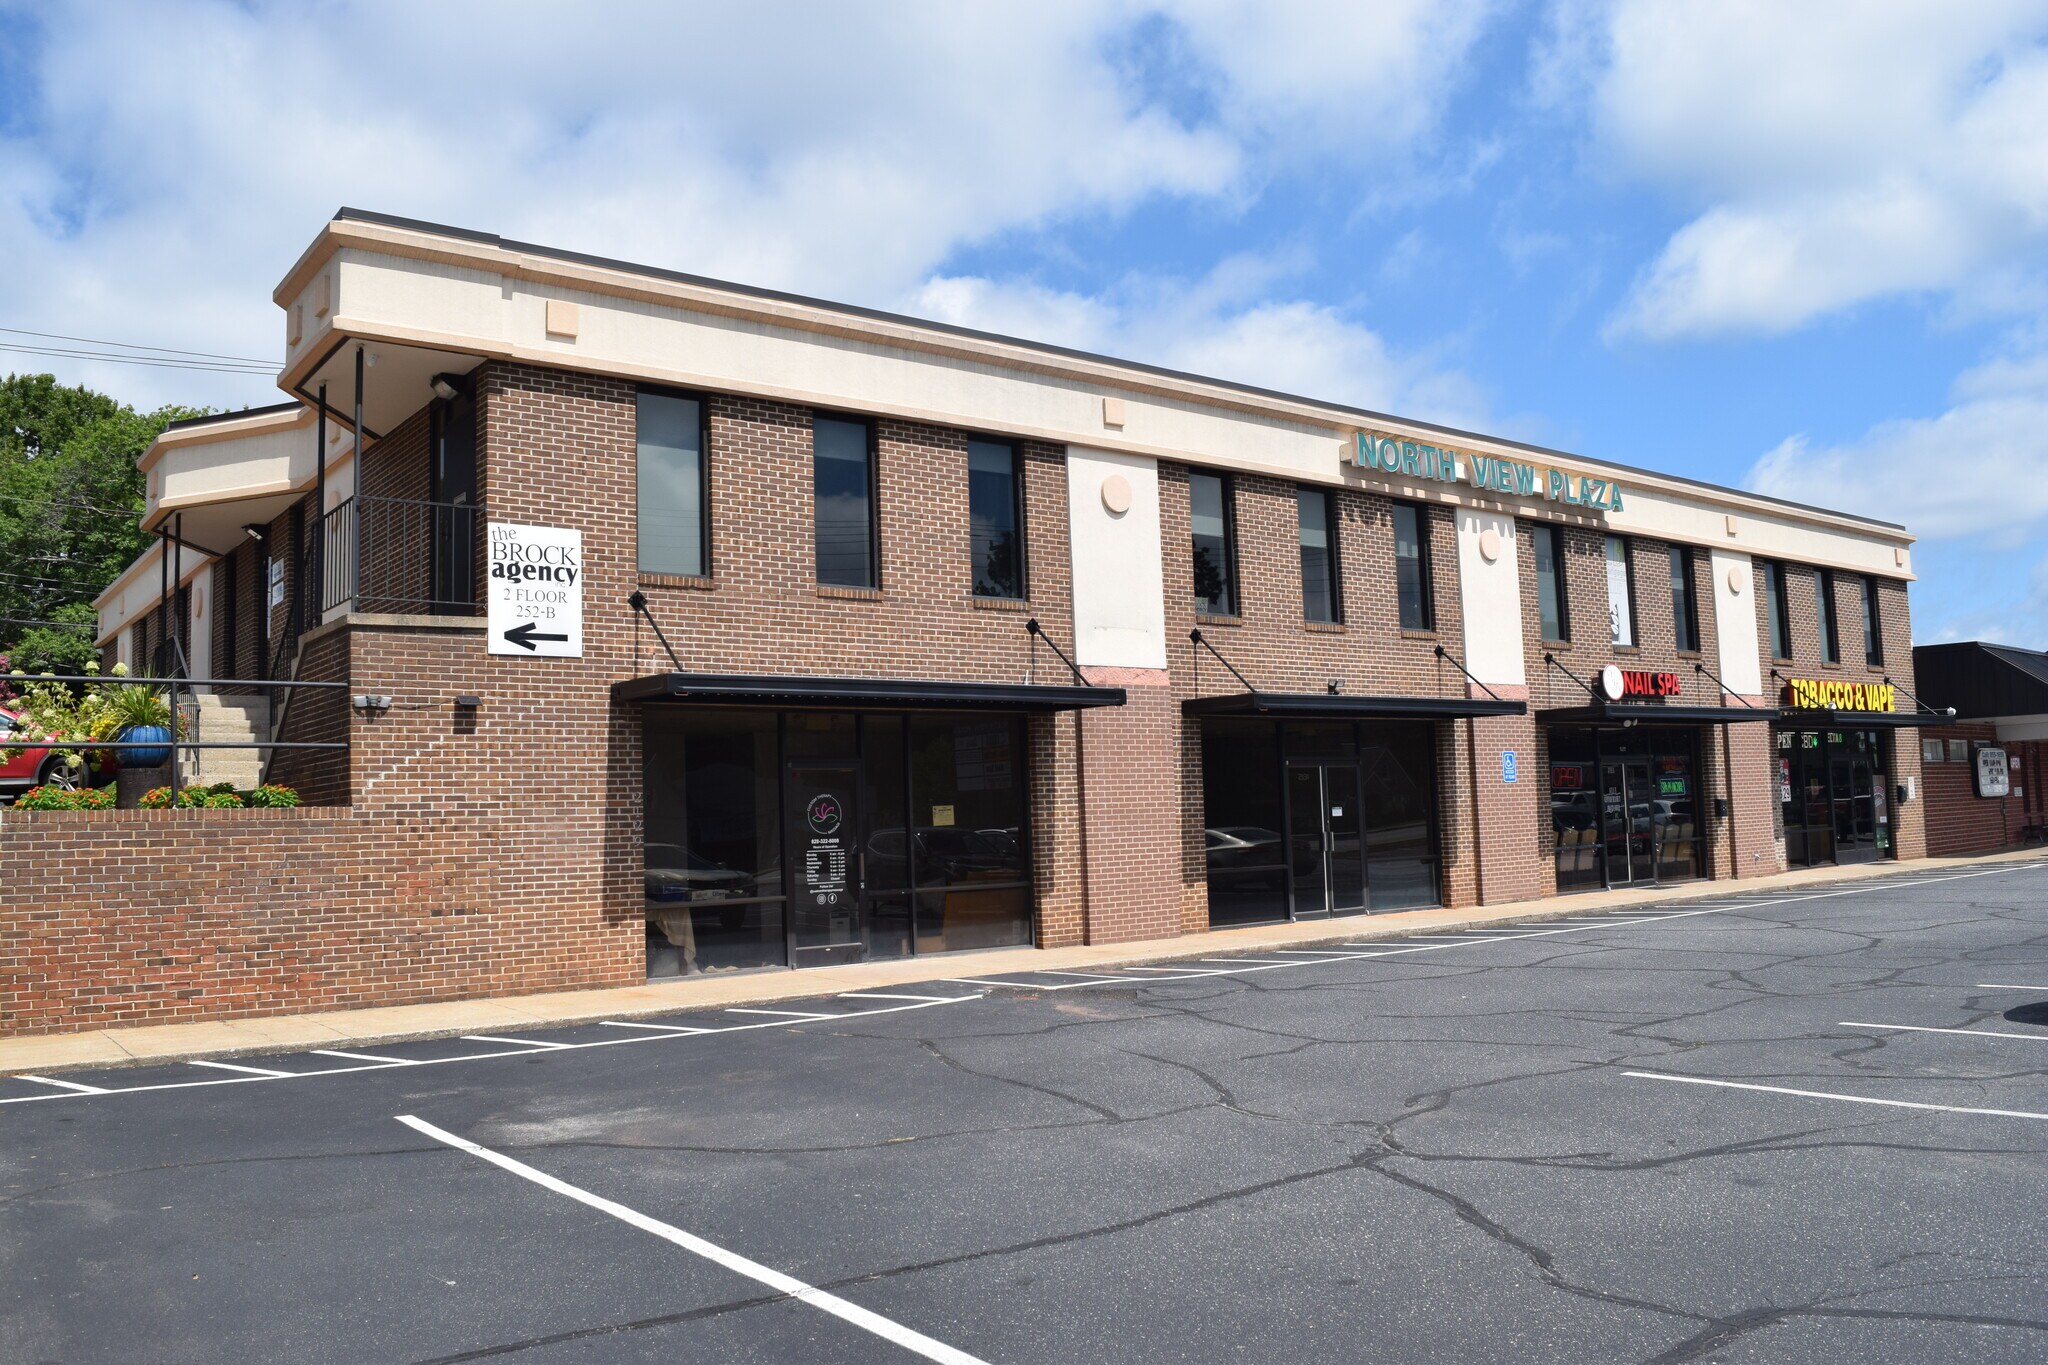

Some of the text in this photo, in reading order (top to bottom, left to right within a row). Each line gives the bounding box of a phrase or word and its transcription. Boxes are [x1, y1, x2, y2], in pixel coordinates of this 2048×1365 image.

[1355, 431, 1624, 512] NORTH VIEW PLAZA
[491, 526, 517, 541] the
[492, 542, 577, 565] BROCK
[491, 561, 578, 587] agency
[503, 588, 568, 604] 2 FLOOR
[516, 604, 556, 619] 252-B
[1623, 671, 1655, 695] NAIL
[1657, 671, 1681, 696] SPA
[1791, 678, 1896, 712] TOBACCO & VAPE
[1777, 734, 1793, 749] PEN
[1553, 767, 1583, 788] OPEN
